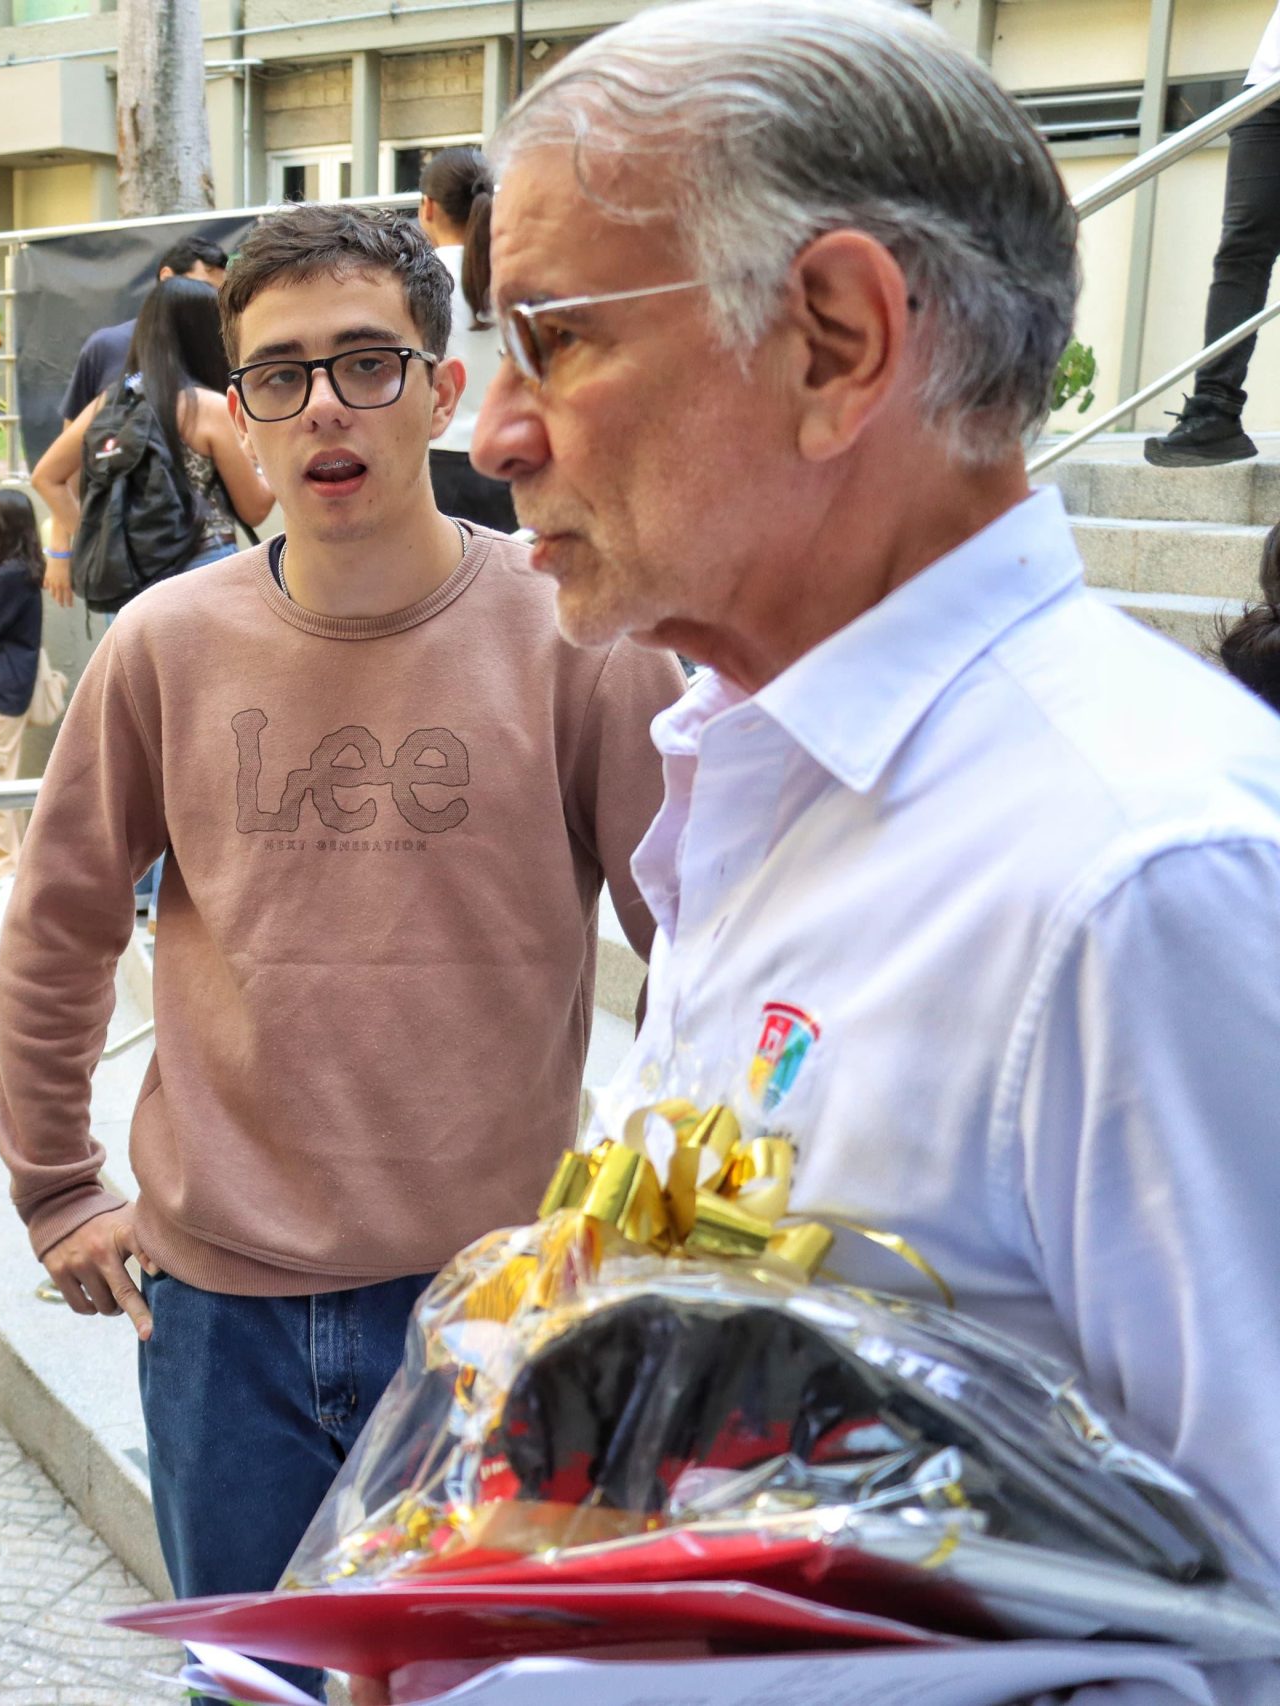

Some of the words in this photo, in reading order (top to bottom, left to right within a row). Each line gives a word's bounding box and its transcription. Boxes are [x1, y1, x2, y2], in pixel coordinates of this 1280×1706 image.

[231, 708, 470, 834] Lee
[264, 839, 307, 851] NEXT
[317, 839, 428, 851] GENERATION
